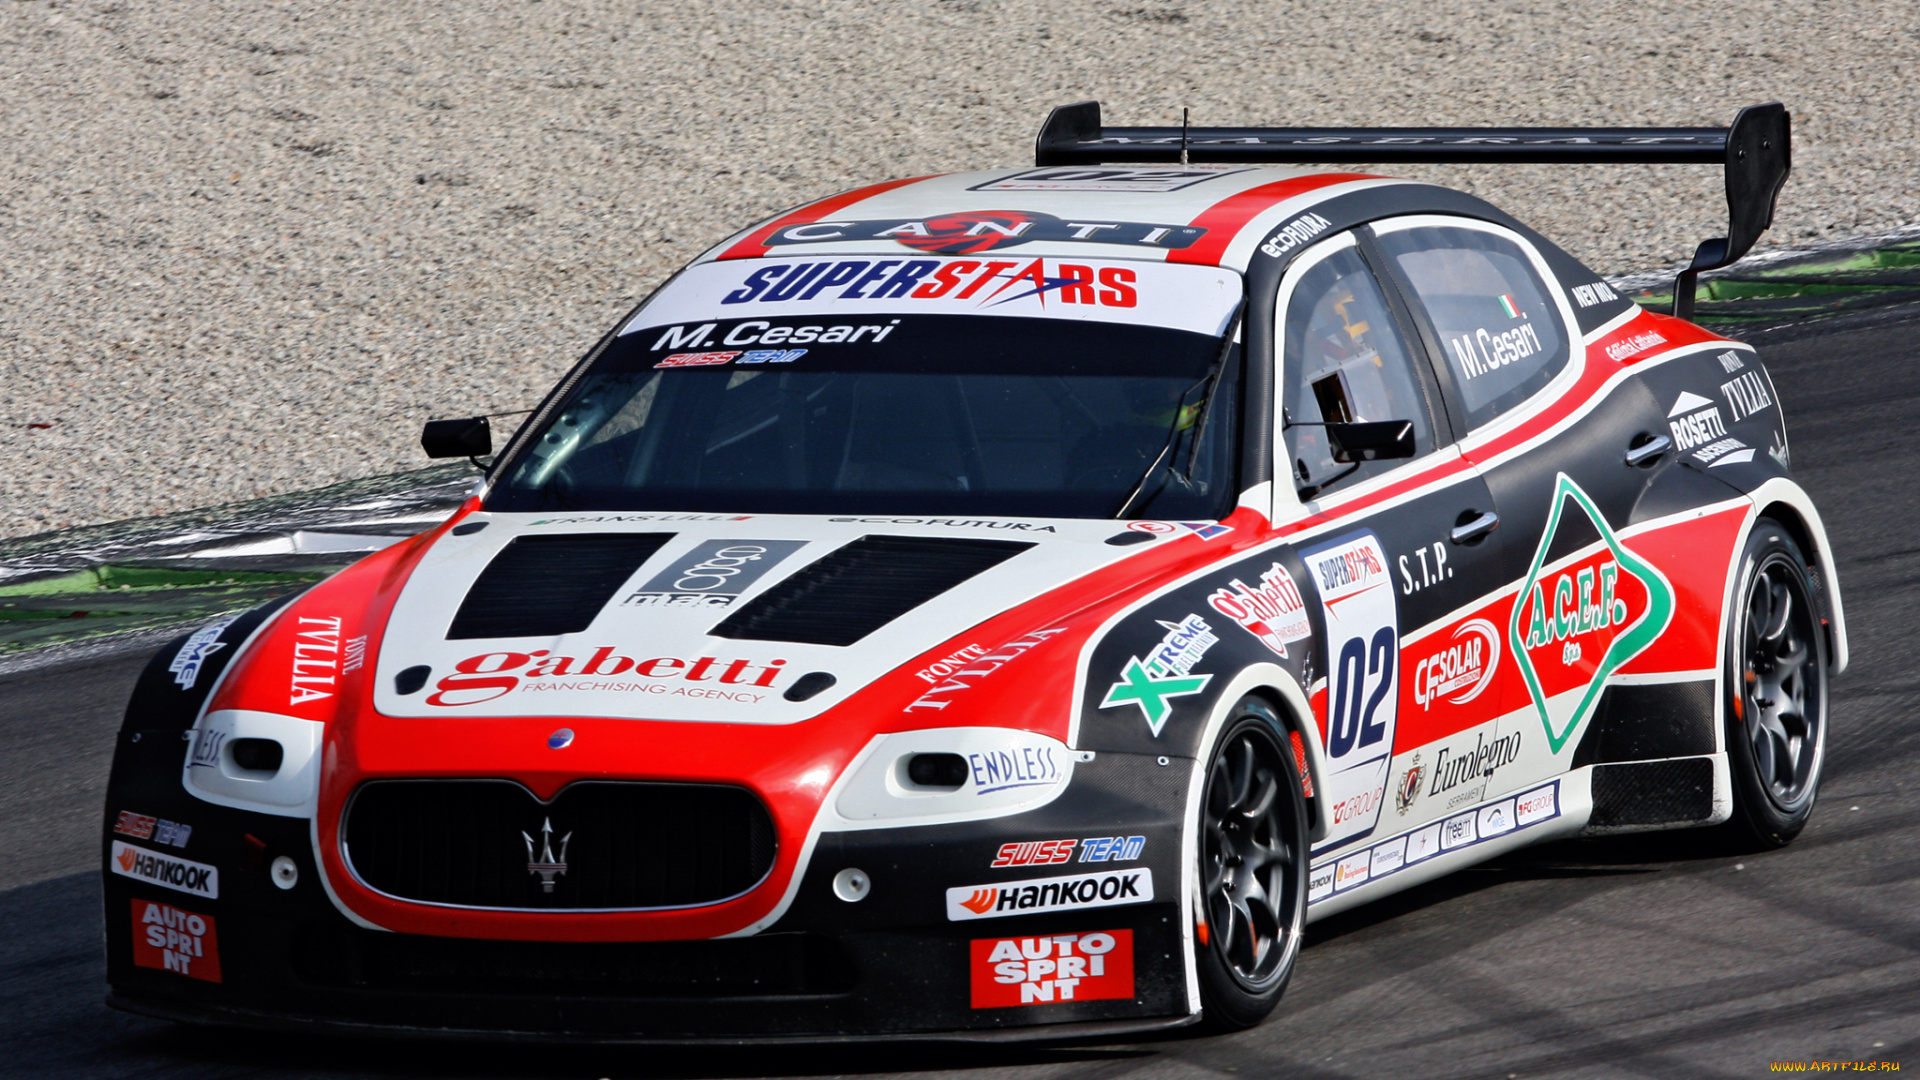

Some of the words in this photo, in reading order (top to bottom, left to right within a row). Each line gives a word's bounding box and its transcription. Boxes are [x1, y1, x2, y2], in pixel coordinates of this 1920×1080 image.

[720, 257, 1138, 311] SUPERSTARS
[653, 350, 744, 369] SWISS
[735, 348, 809, 364] TEAM
[1317, 544, 1383, 592] SUPERSTARS
[1398, 541, 1453, 596] S.T.P.
[1212, 567, 1304, 656] gabetti
[1526, 559, 1628, 651] A.C.E.F.
[289, 615, 342, 706] TVLLIA
[424, 646, 788, 707] gabetti
[902, 626, 1070, 713] TVLLIA
[914, 643, 992, 685] FONTE
[1439, 636, 1482, 683] SOLAR
[520, 680, 668, 697] FRANCHISING
[671, 687, 767, 704] AGENCY
[1329, 626, 1397, 760] 02
[968, 746, 1057, 787] ENDLESS
[1427, 730, 1523, 798] Eurolegno
[112, 810, 157, 840] SWISS
[154, 818, 192, 848] TEAM
[990, 838, 1079, 868] SWISS
[1077, 836, 1146, 863] TEAM
[141, 903, 208, 937] AUTO
[146, 924, 204, 958] SPRI
[163, 949, 191, 976] NT
[986, 932, 1117, 963] AUTO
[993, 954, 1106, 984] SPRI
[1020, 978, 1081, 1004] NT
